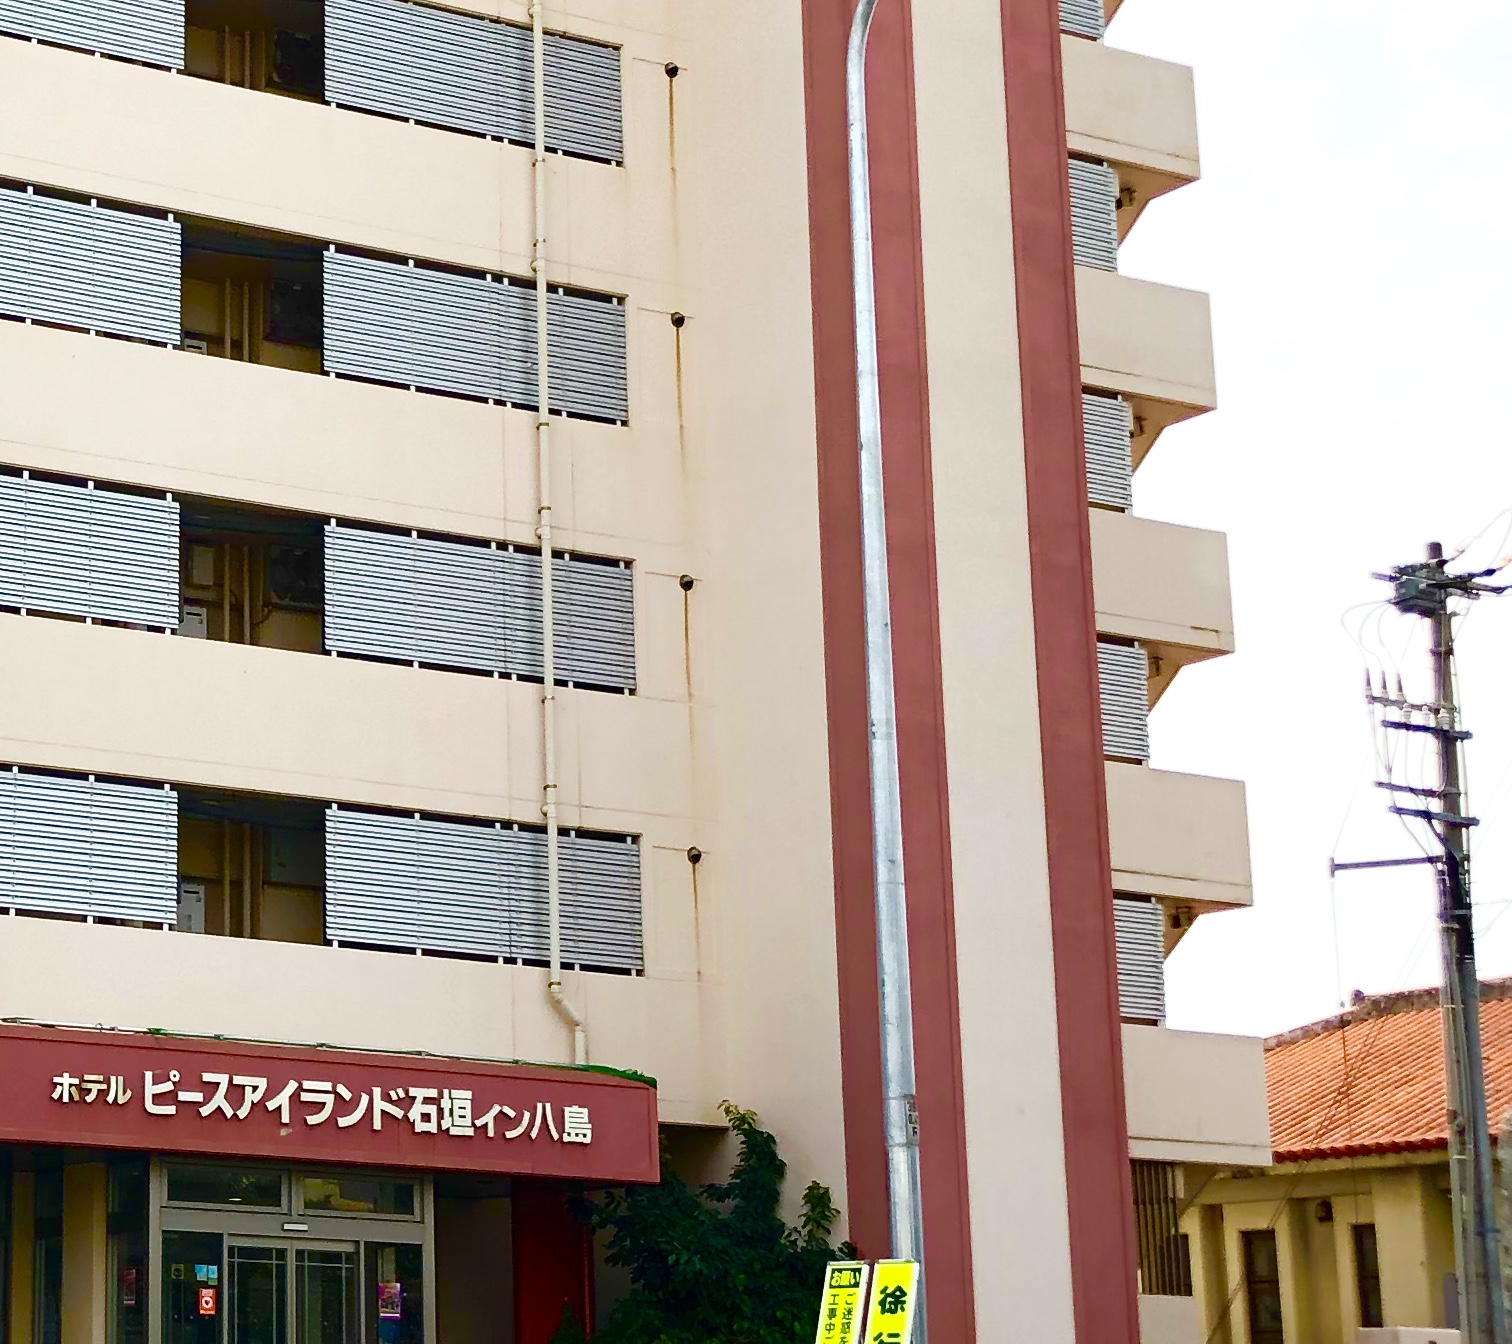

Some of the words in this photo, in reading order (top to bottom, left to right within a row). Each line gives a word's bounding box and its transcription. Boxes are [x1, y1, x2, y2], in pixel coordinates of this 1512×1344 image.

[50, 1071, 132, 1105] ホテル
[831, 1270, 860, 1287] お願い
